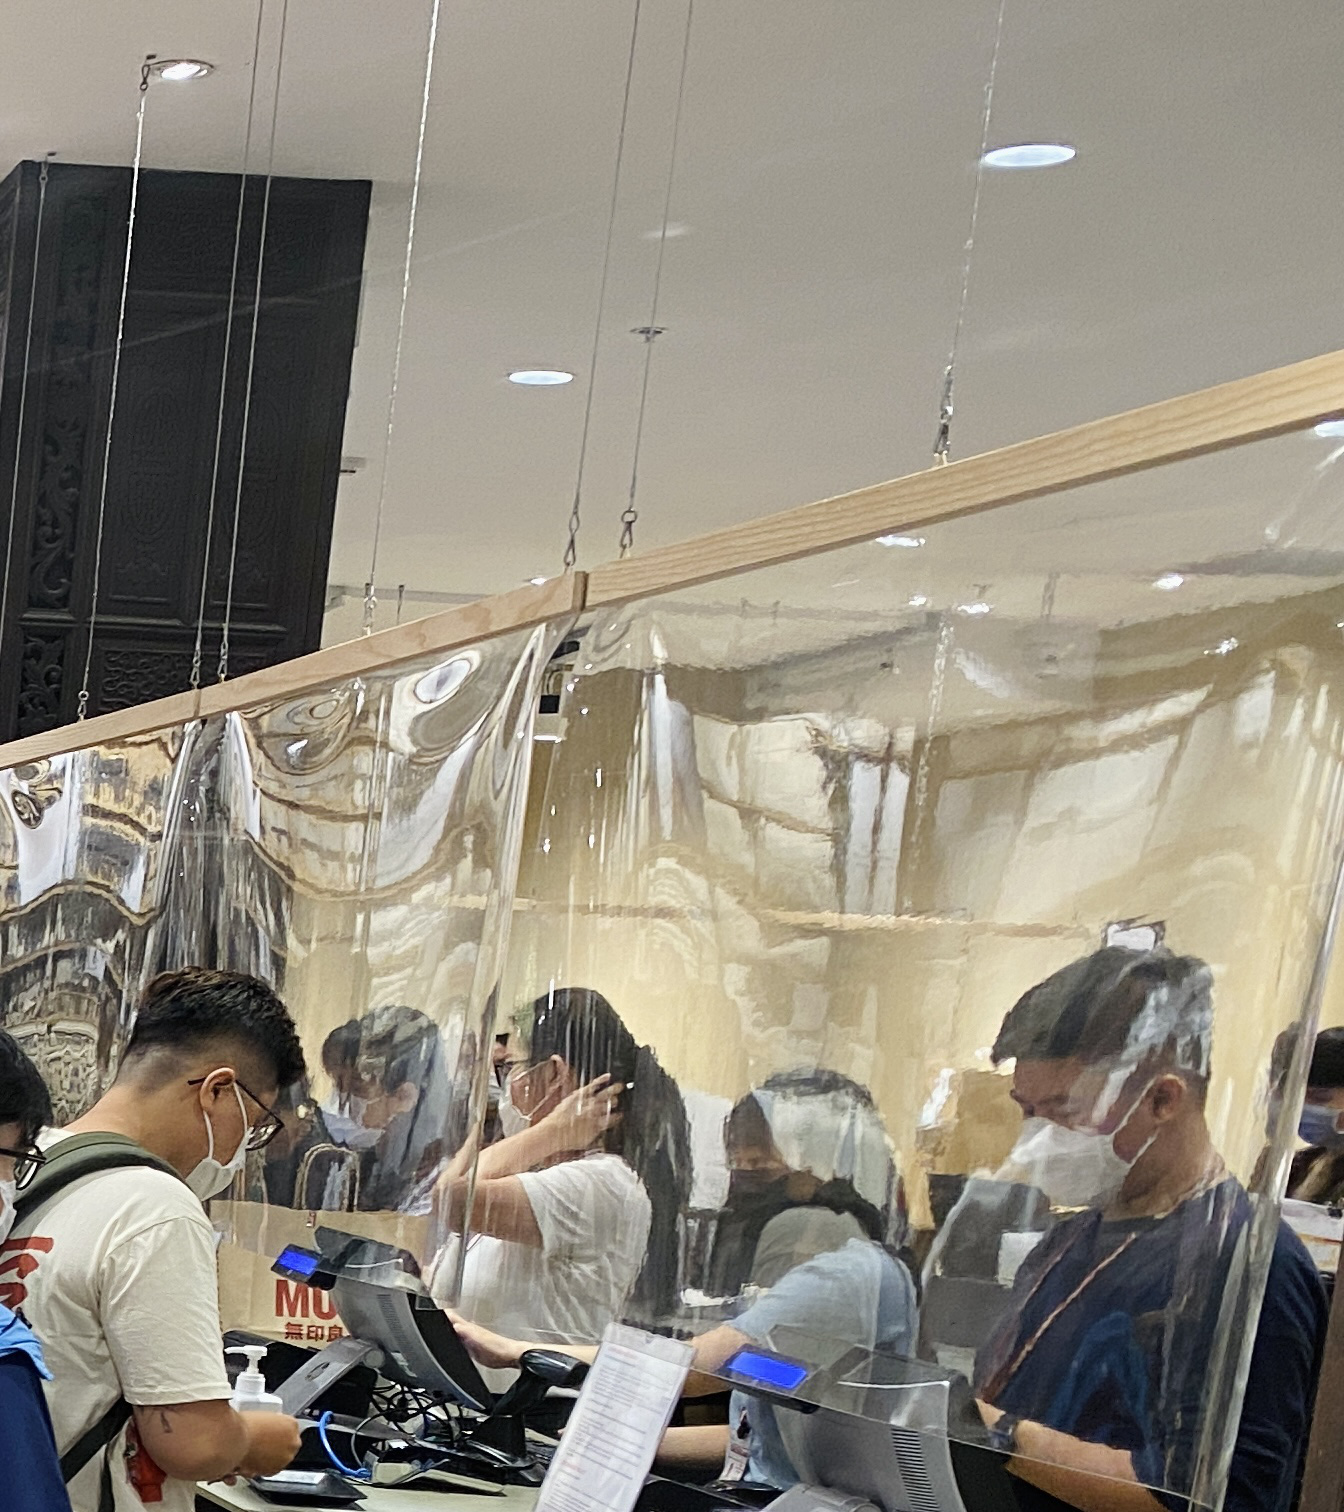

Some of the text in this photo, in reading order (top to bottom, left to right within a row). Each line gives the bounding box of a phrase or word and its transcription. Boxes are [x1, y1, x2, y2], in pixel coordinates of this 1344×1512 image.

[275, 1279, 338, 1321] MU
[284, 1321, 344, 1343] 無印良
